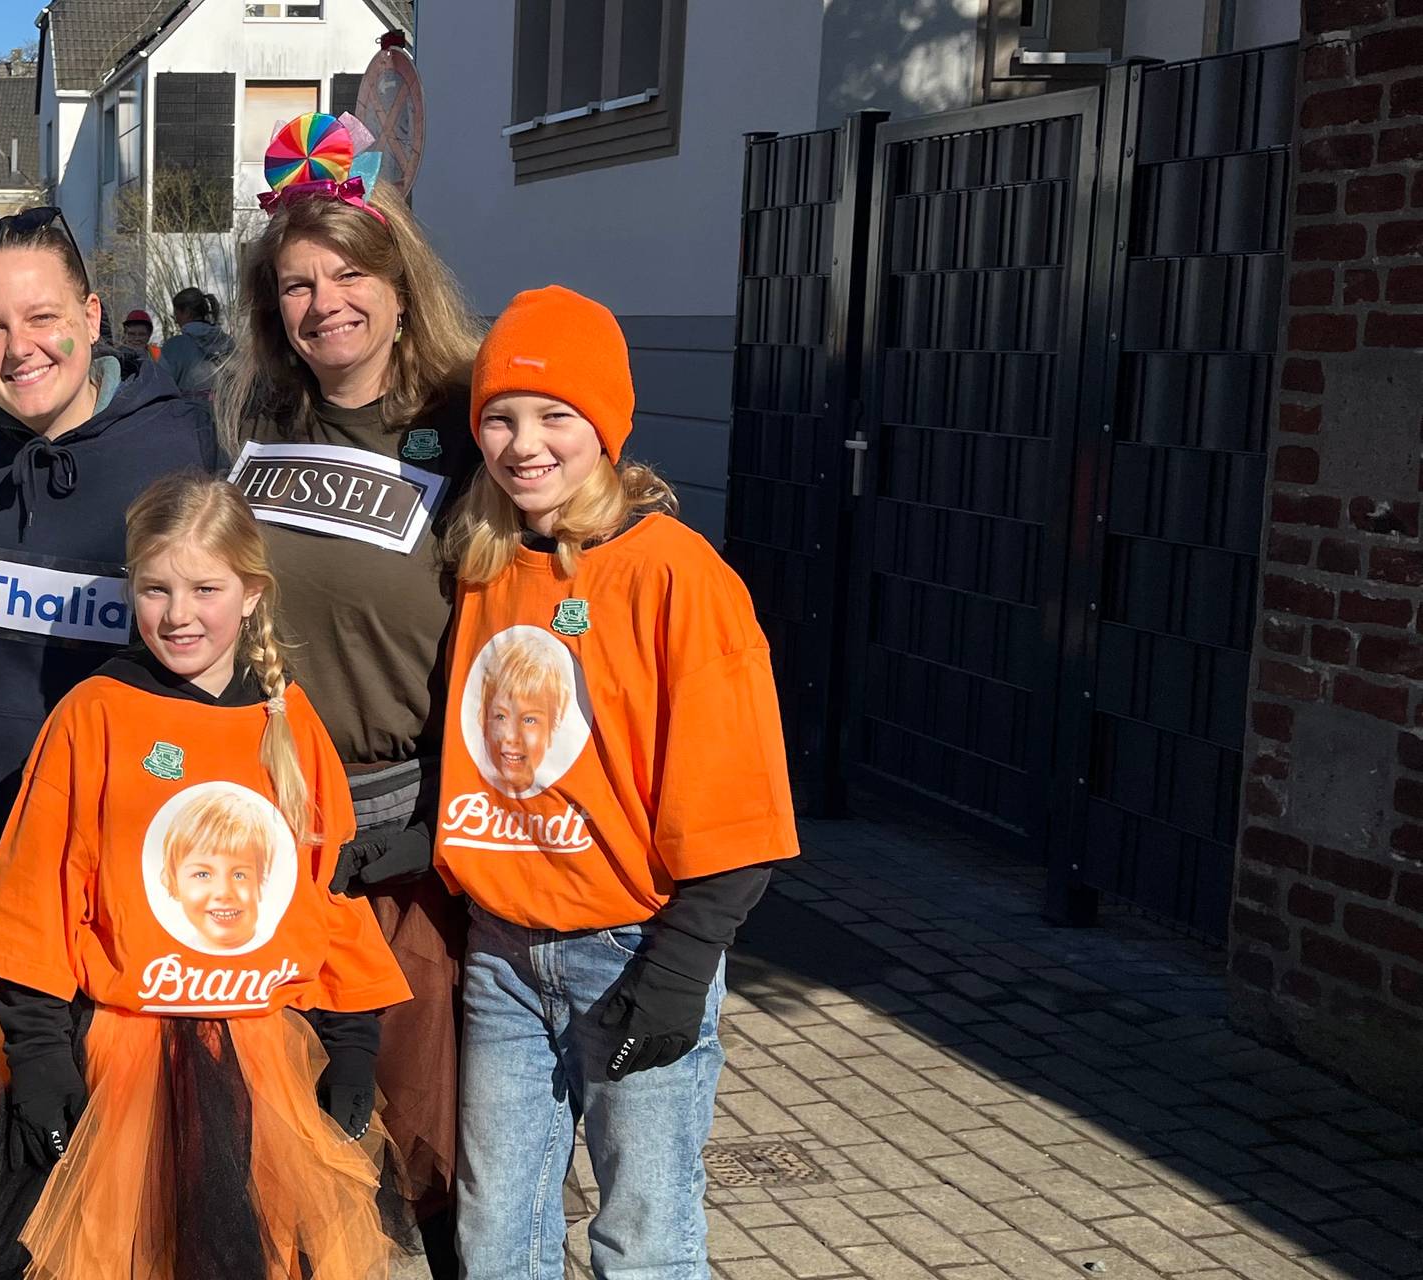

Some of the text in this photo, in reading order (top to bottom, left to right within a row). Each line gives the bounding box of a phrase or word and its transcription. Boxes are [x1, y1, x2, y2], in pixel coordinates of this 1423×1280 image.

[243, 467, 395, 522] HUSSEL
[442, 791, 593, 854] Brandt
[137, 953, 299, 1002] Brandt
[611, 1038, 636, 1071] KIPSTA
